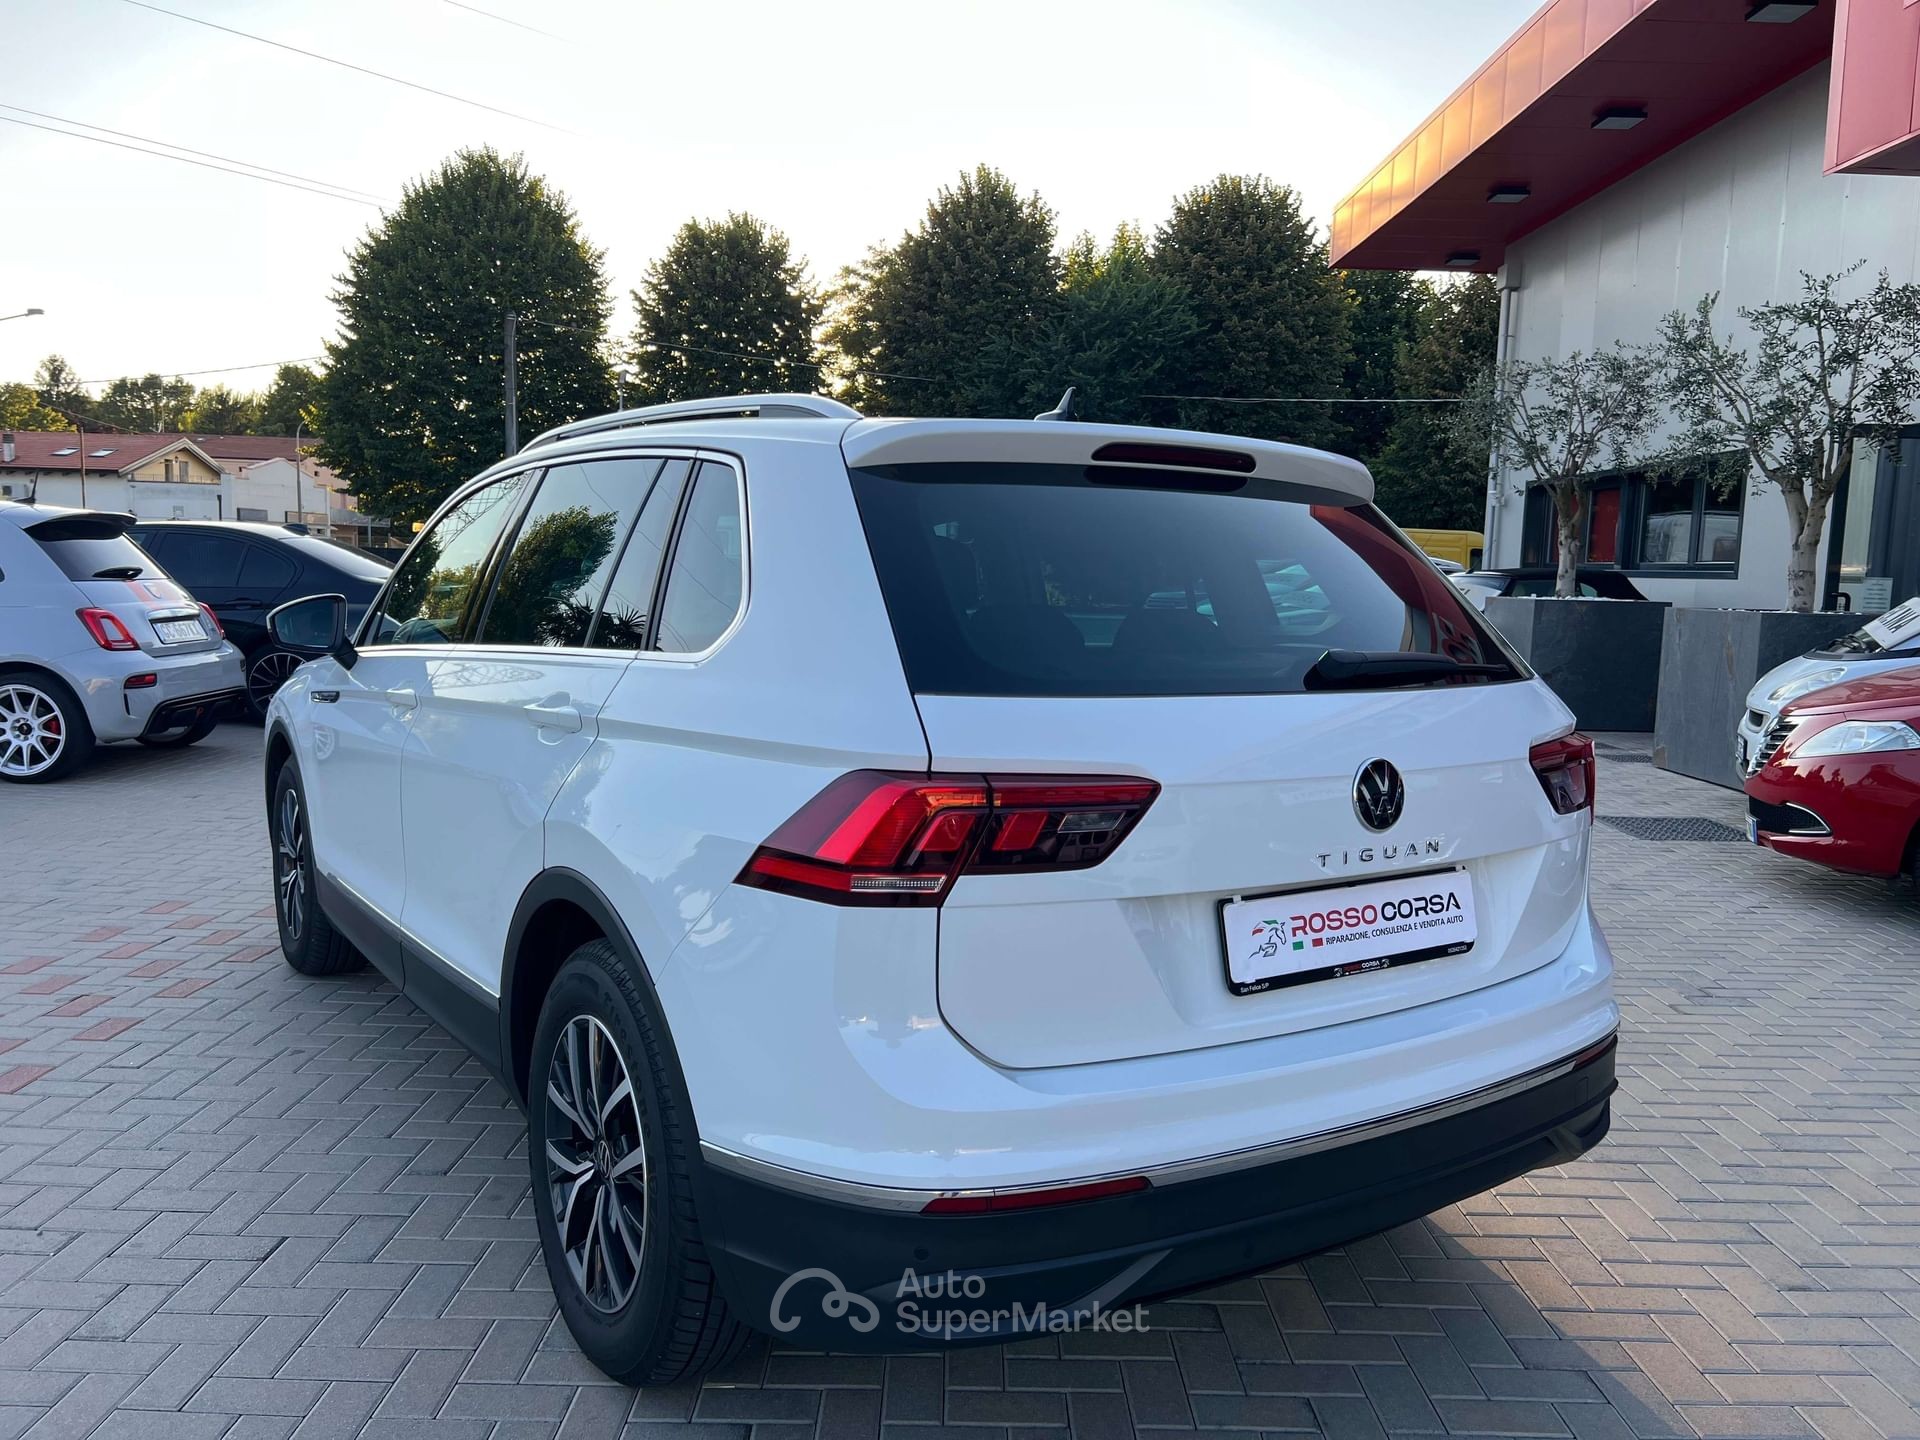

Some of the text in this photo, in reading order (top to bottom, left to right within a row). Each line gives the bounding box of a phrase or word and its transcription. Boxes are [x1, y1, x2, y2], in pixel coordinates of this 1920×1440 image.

[1316, 839, 1440, 868] TIGUAN
[1289, 891, 1462, 938] ROSSO CORSA
[1325, 931, 1371, 945] RIPARAZIONE,
[1371, 923, 1413, 938] CONSULENZA
[1418, 918, 1446, 930] VENDITA
[1446, 914, 1464, 925] AUTO
